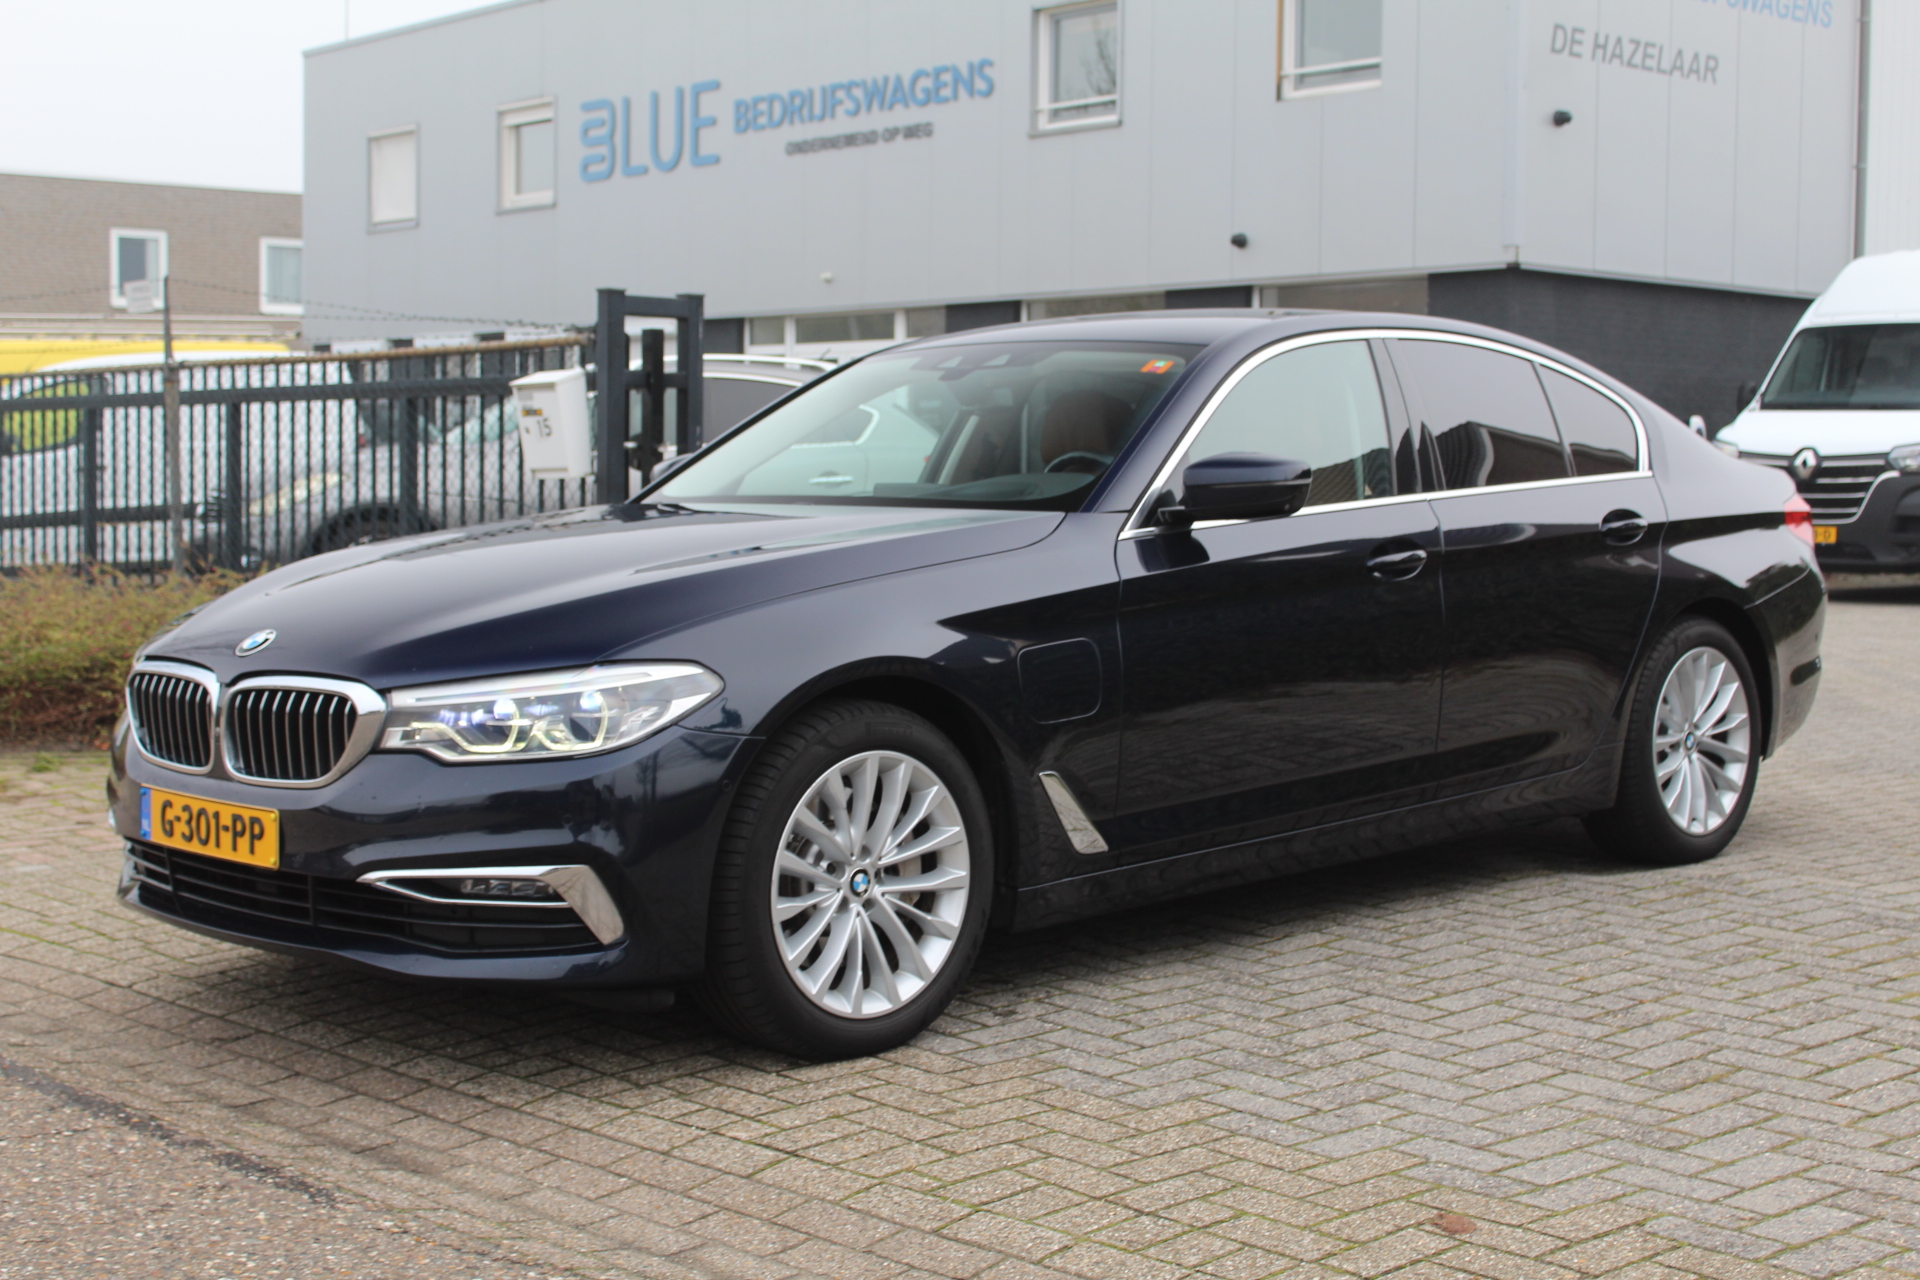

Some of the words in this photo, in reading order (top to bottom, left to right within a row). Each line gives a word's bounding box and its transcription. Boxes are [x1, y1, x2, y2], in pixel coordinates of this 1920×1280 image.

[1551, 23, 1586, 59] DE
[1591, 31, 1720, 85] HAZELAAR
[579, 79, 721, 183] BLUE
[733, 58, 995, 134] BEDRIJFSWAGENS
[882, 126, 901, 143] OP
[537, 417, 552, 438] 15
[161, 799, 265, 855] G-301-PP
